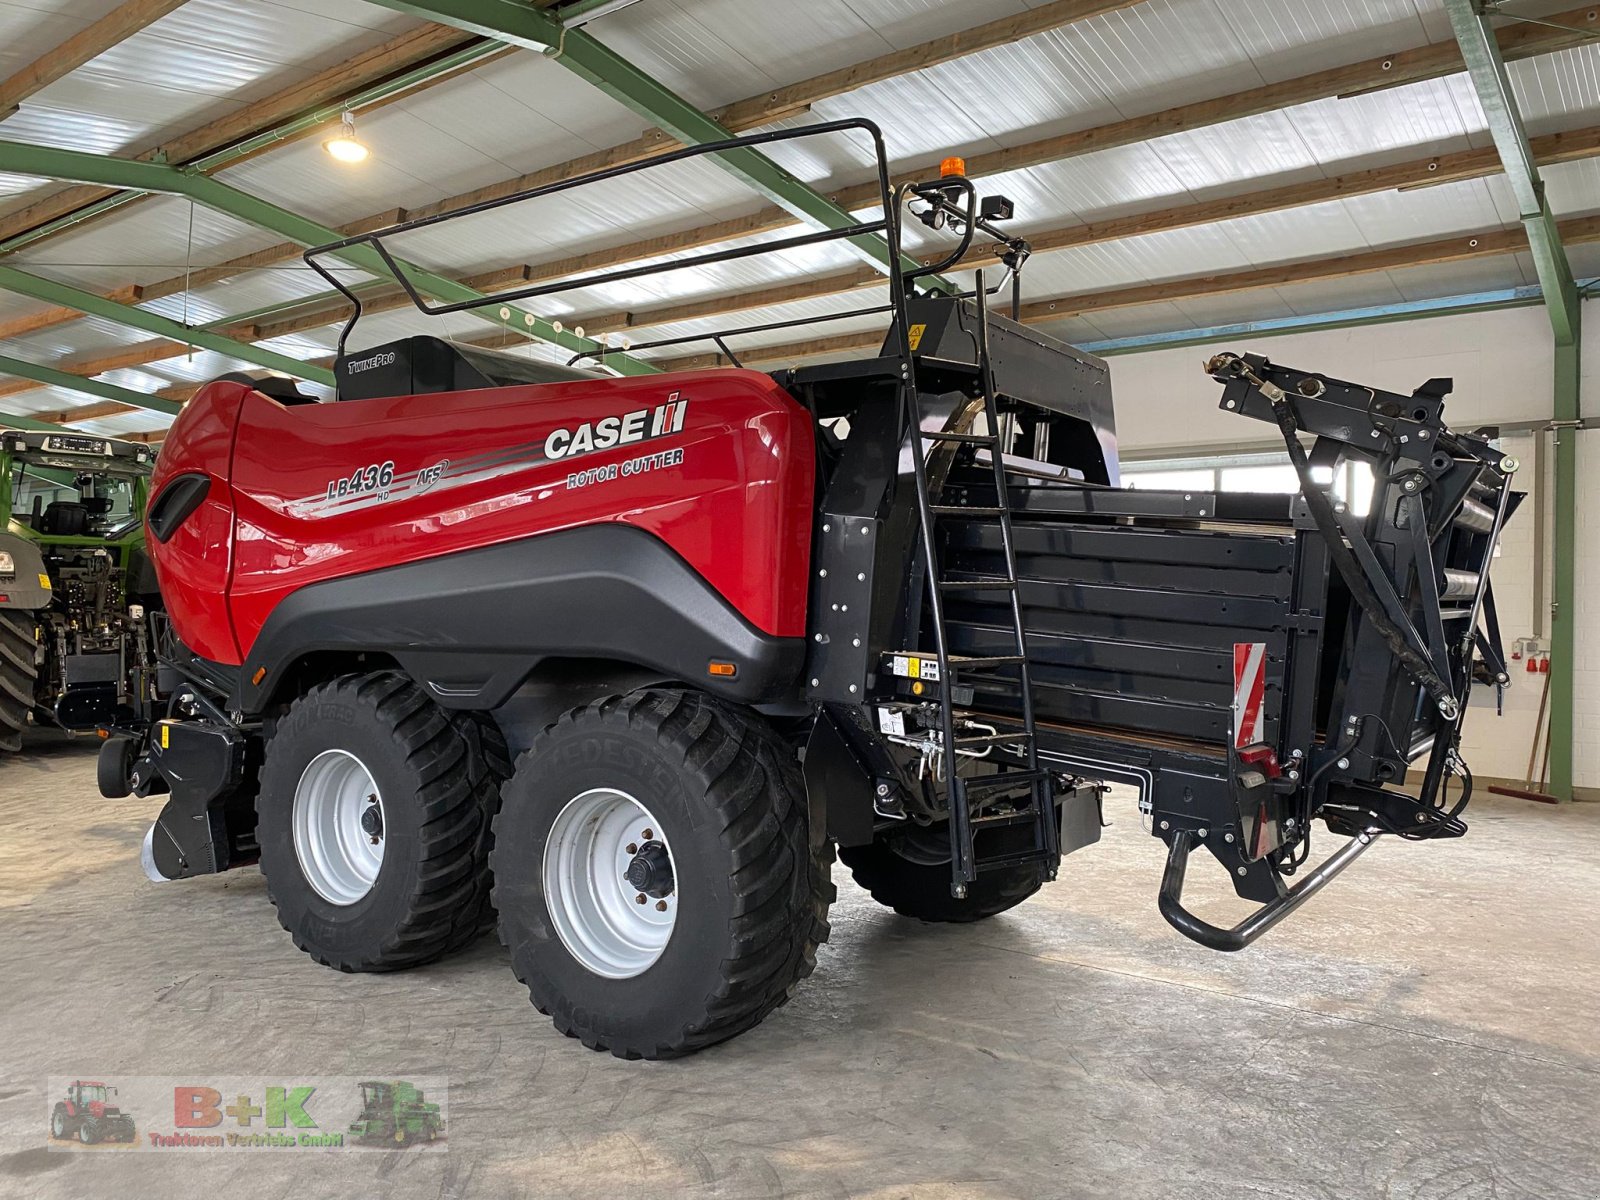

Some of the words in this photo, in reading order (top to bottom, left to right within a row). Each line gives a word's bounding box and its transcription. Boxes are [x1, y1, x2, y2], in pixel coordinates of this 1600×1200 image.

[544, 410, 648, 460] CASE
[416, 464, 442, 486] AFS
[567, 464, 617, 489] ROTOR
[621, 448, 684, 477] CUTTER
[377, 491, 389, 502] HD
